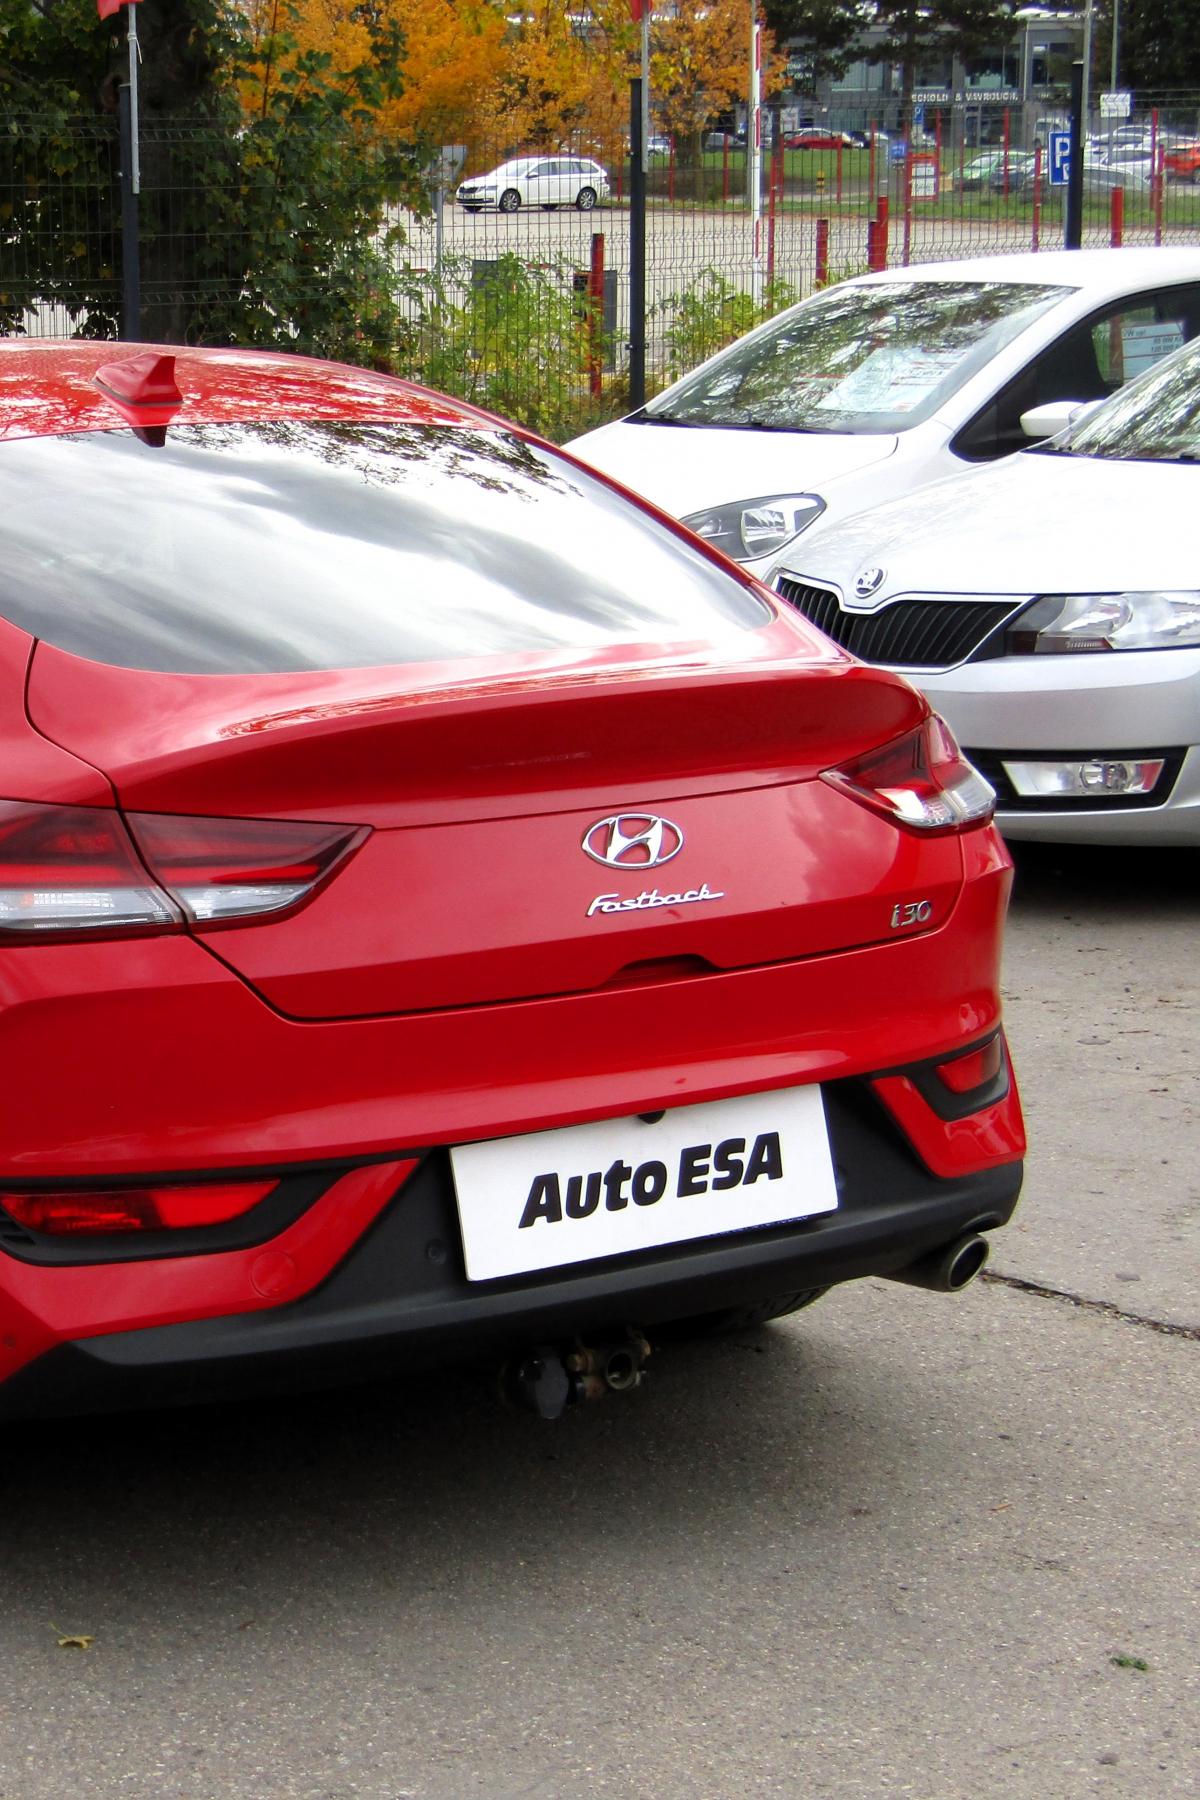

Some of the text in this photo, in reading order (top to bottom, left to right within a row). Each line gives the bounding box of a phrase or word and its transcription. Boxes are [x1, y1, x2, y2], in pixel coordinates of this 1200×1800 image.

[585, 883, 724, 917] Fastback
[891, 900, 931, 928] i30
[518, 1131, 783, 1229] Auto ESA
